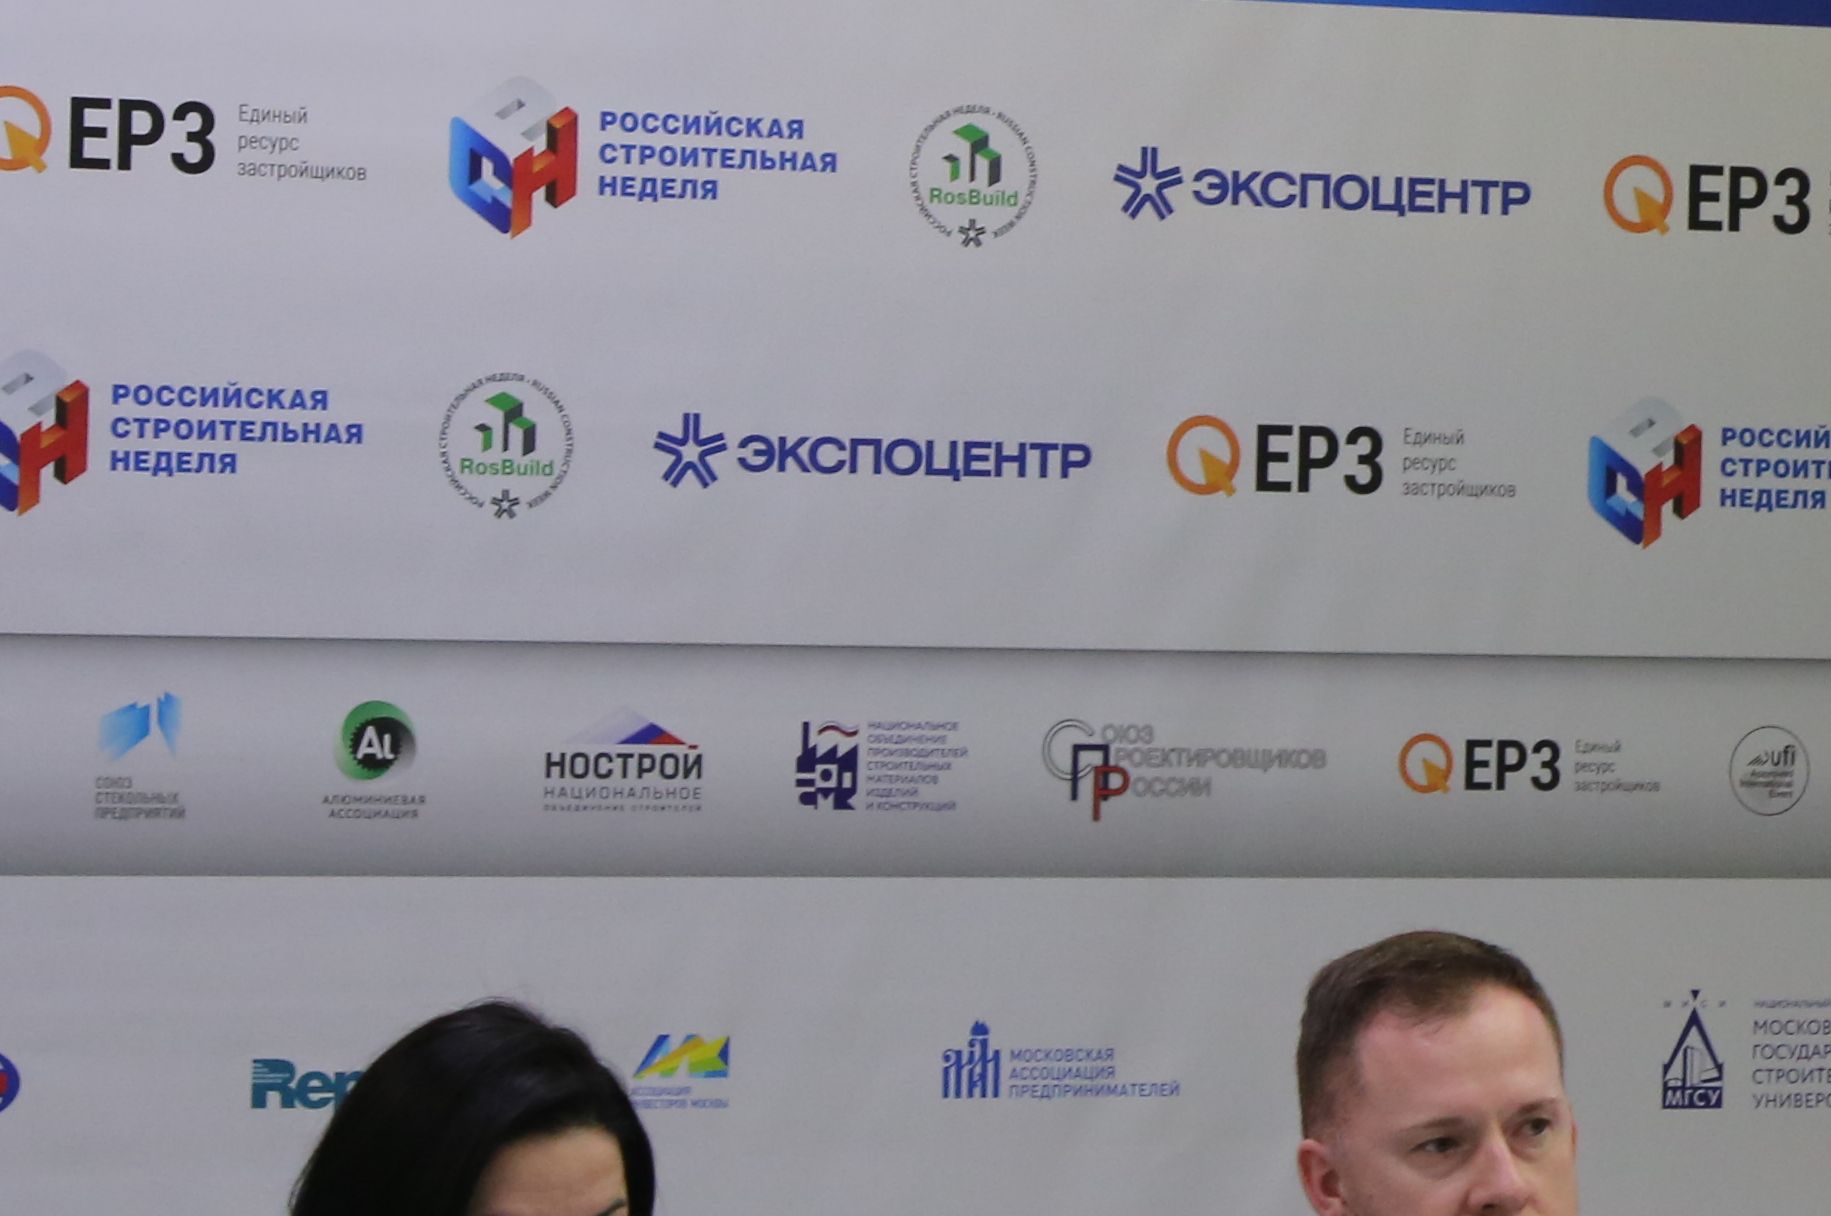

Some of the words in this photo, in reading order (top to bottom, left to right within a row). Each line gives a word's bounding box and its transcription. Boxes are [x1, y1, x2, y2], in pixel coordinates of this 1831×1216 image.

[237, 104, 308, 125] Единый
[600, 110, 805, 140] РОССИЙСКАЯ
[237, 133, 300, 153] ресурс
[600, 143, 838, 173] СТРОИТЕЛЬНАЯ
[237, 159, 367, 181] застройщиков
[599, 176, 719, 201] НЕДЕЛЯ
[929, 187, 1018, 207] RosBuild
[1192, 168, 1532, 217] ЭКСПОЦЕНТР
[111, 381, 329, 411] РОССИЙСКАЯ
[110, 417, 363, 445] СТРОИТЕЛЬНАЯ
[1402, 427, 1464, 446] Единый
[110, 450, 237, 476] НЕДЕЛЯ
[459, 457, 554, 476] RosBuild
[736, 434, 1092, 482] ЭКСПОЦЕНТР
[1402, 456, 1456, 473] ресурс
[1402, 479, 1516, 499] застройщиков
[1720, 488, 1826, 513] НЕДЕЛЯ
[1574, 740, 1621, 754] Единый
[1574, 762, 1616, 775] ресурс
[543, 786, 702, 801] НАЦИОНАЛЬНОЕ
[1009, 1047, 1115, 1063] МОСКОВСКАЯ
[1009, 1065, 1116, 1082] АССОЦИАЦИЯ
[1009, 1080, 1180, 1100] ПРЕДПРИНИМАТЕЛЕЙ
[1664, 1089, 1721, 1107] МГСУ
